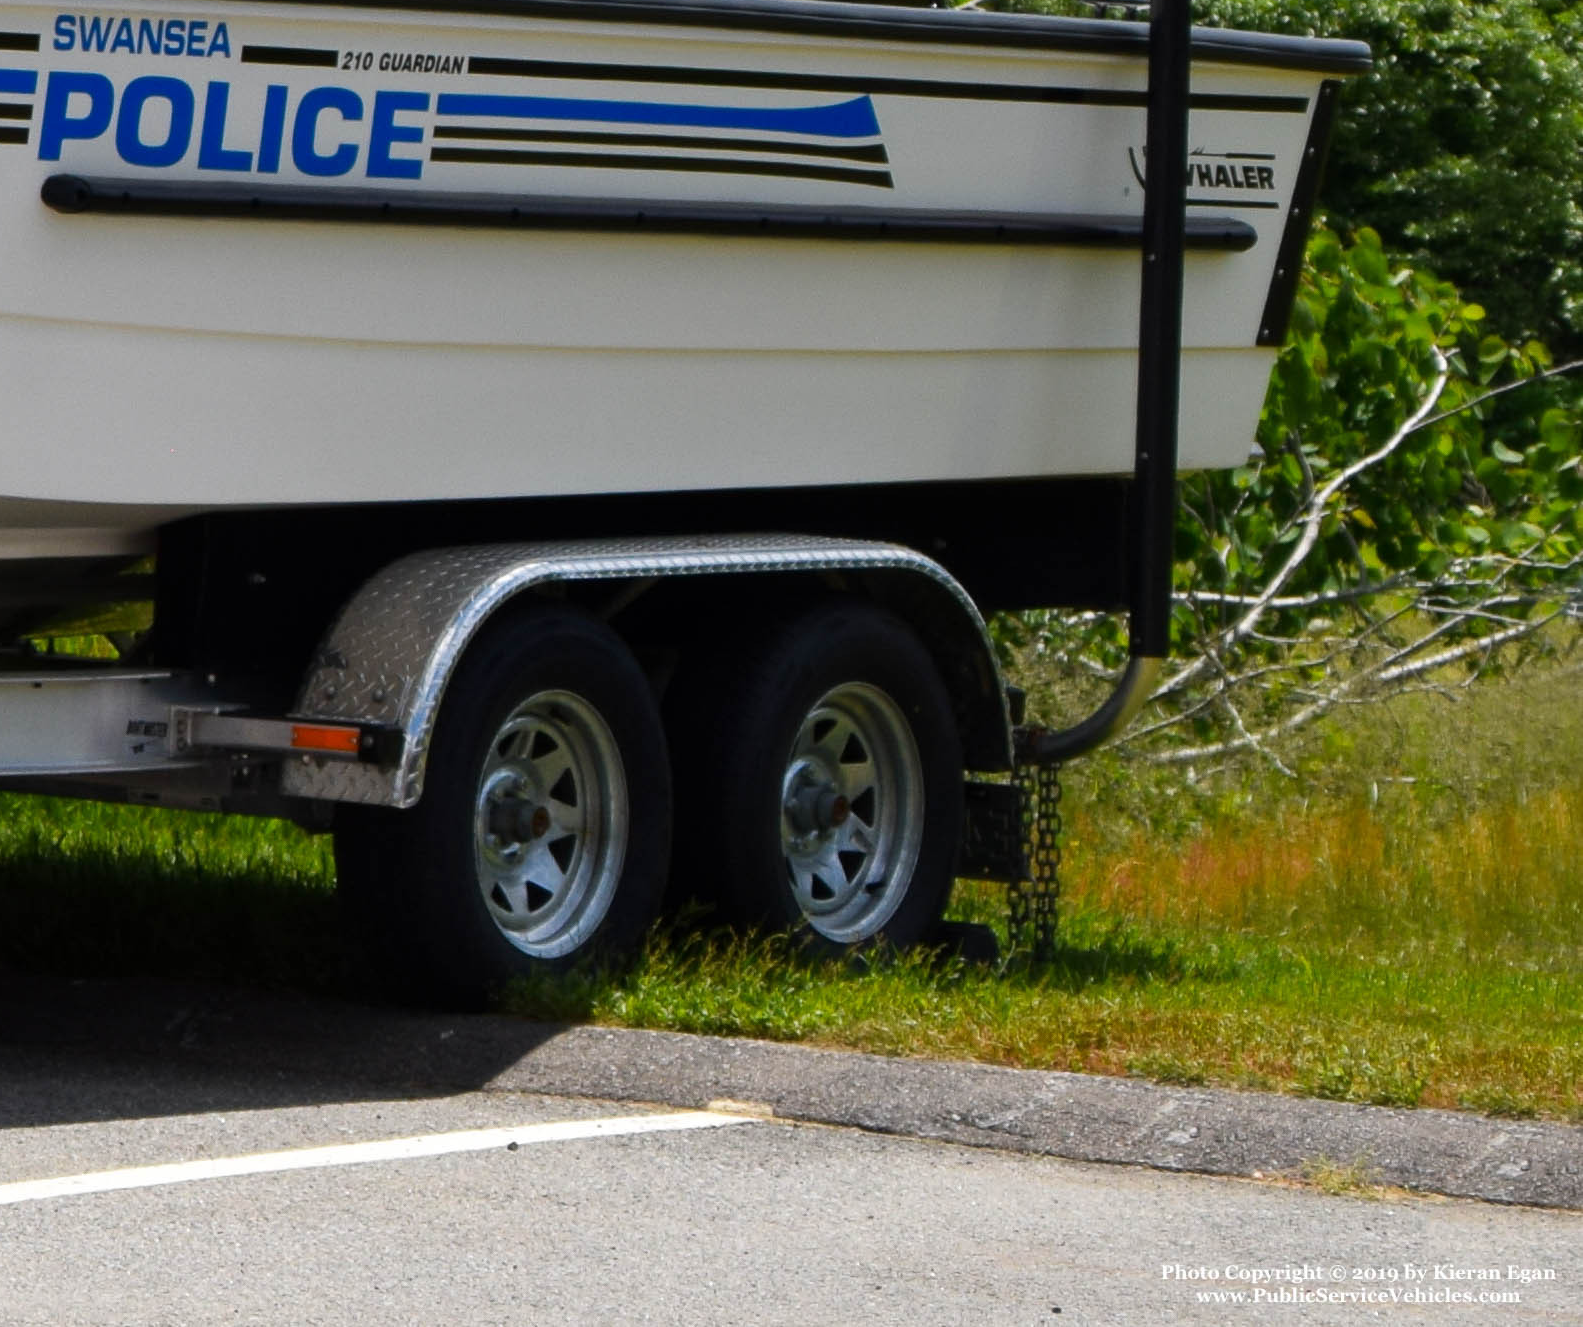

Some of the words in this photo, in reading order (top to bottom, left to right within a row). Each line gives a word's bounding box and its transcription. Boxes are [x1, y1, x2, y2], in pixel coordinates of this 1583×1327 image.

[53, 14, 231, 58] SWANSEA
[342, 52, 374, 71] 210
[379, 53, 465, 74] GUARDIAN
[38, 71, 431, 180] POLICE
